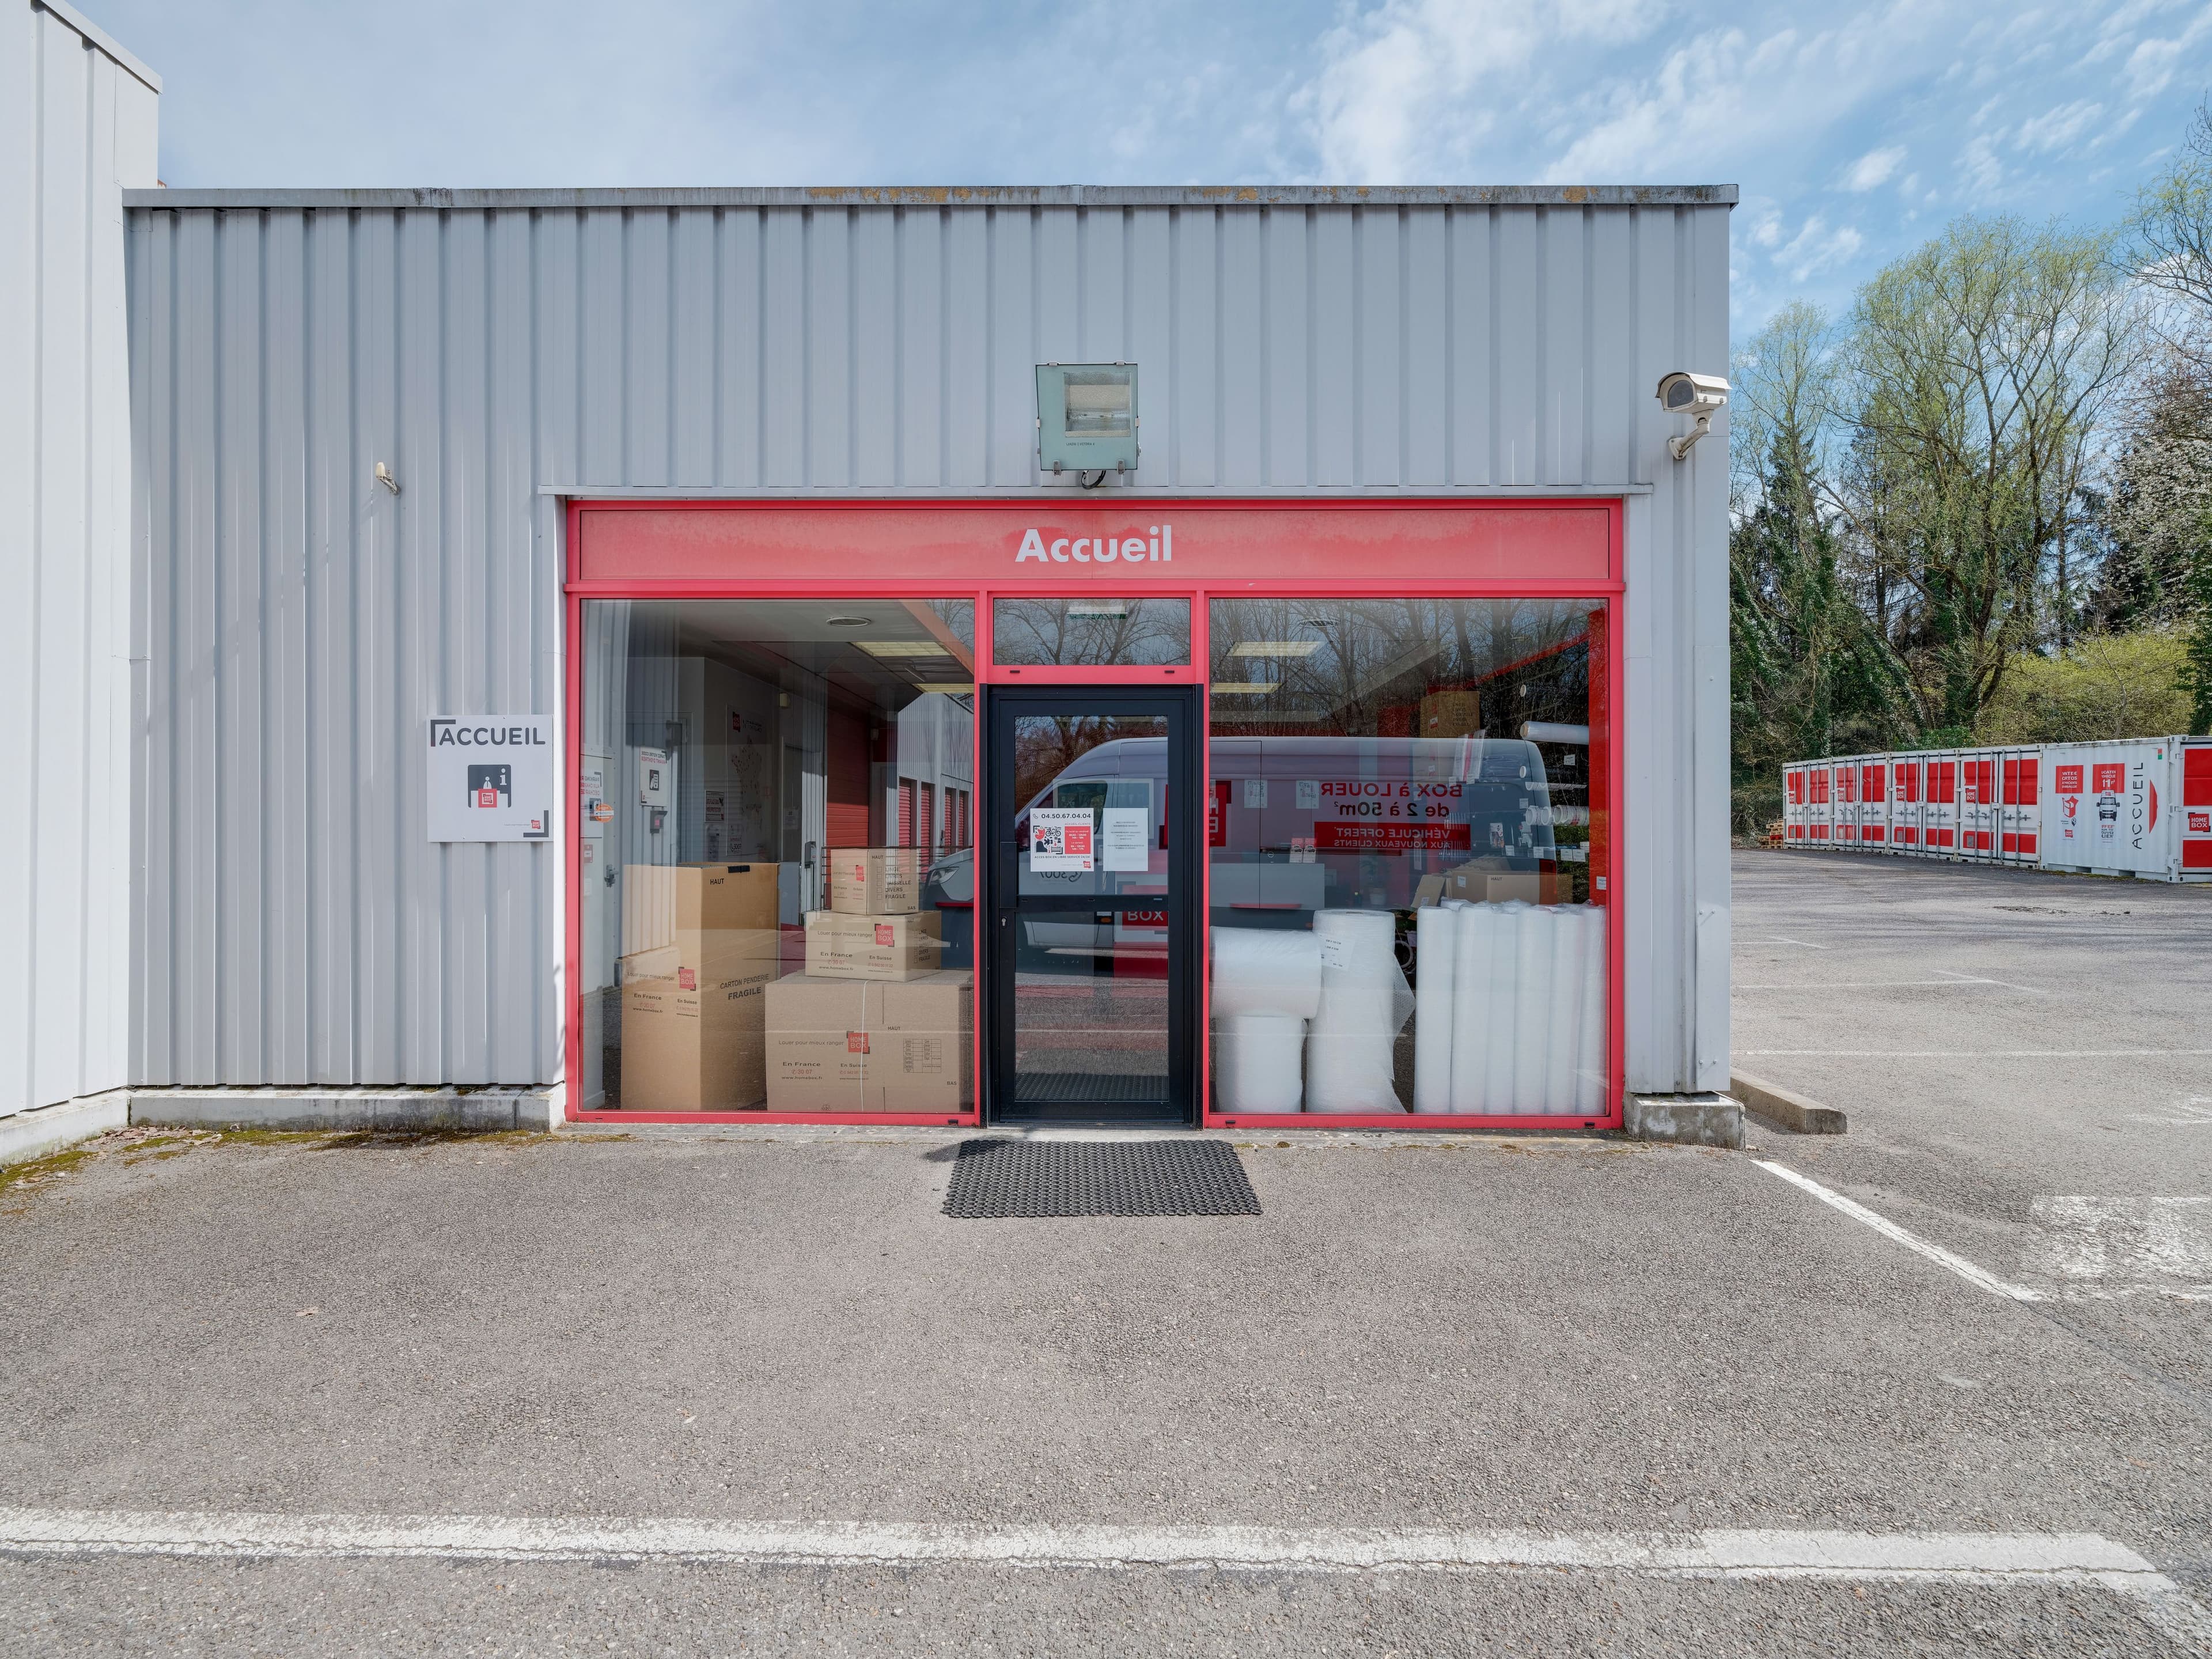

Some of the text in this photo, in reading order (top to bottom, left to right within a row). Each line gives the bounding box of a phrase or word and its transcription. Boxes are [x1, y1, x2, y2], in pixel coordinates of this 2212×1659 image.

[1015, 525, 1172, 562] Accueil
[439, 727, 546, 746] ACCUEIL
[2132, 762, 2143, 849] ACCUEIL
[1128, 911, 1164, 921] BOX
[720, 974, 769, 990] CARTON PENDERIE
[728, 987, 762, 1000] FRAGILE
